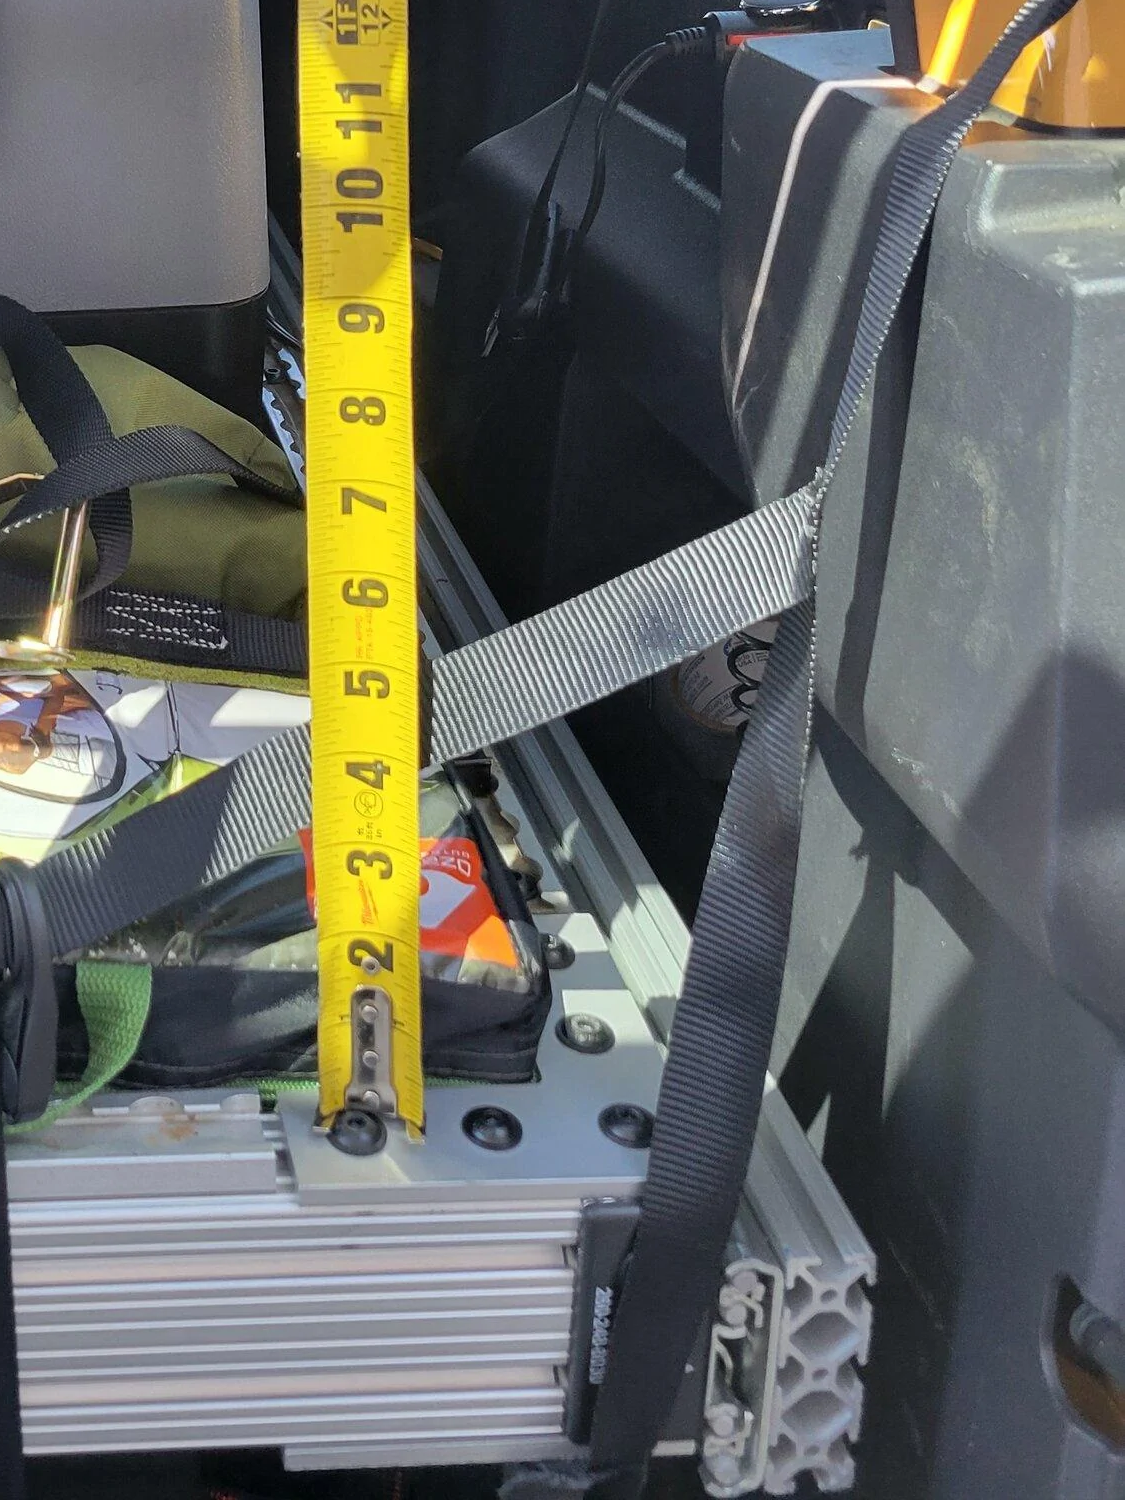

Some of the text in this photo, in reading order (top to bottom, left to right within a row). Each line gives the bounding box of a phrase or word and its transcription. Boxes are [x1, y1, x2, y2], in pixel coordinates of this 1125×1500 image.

[361, 3, 379, 35] 12
[335, 82, 382, 140] 11
[336, 168, 384, 233] 10
[337, 302, 385, 334] 9
[339, 396, 387, 427] 8
[341, 486, 387, 516] 7
[342, 578, 389, 609] 6
[344, 669, 390, 699] 5
[346, 759, 391, 790] 4
[346, 849, 392, 880] 3
[347, 937, 394, 974] 2
